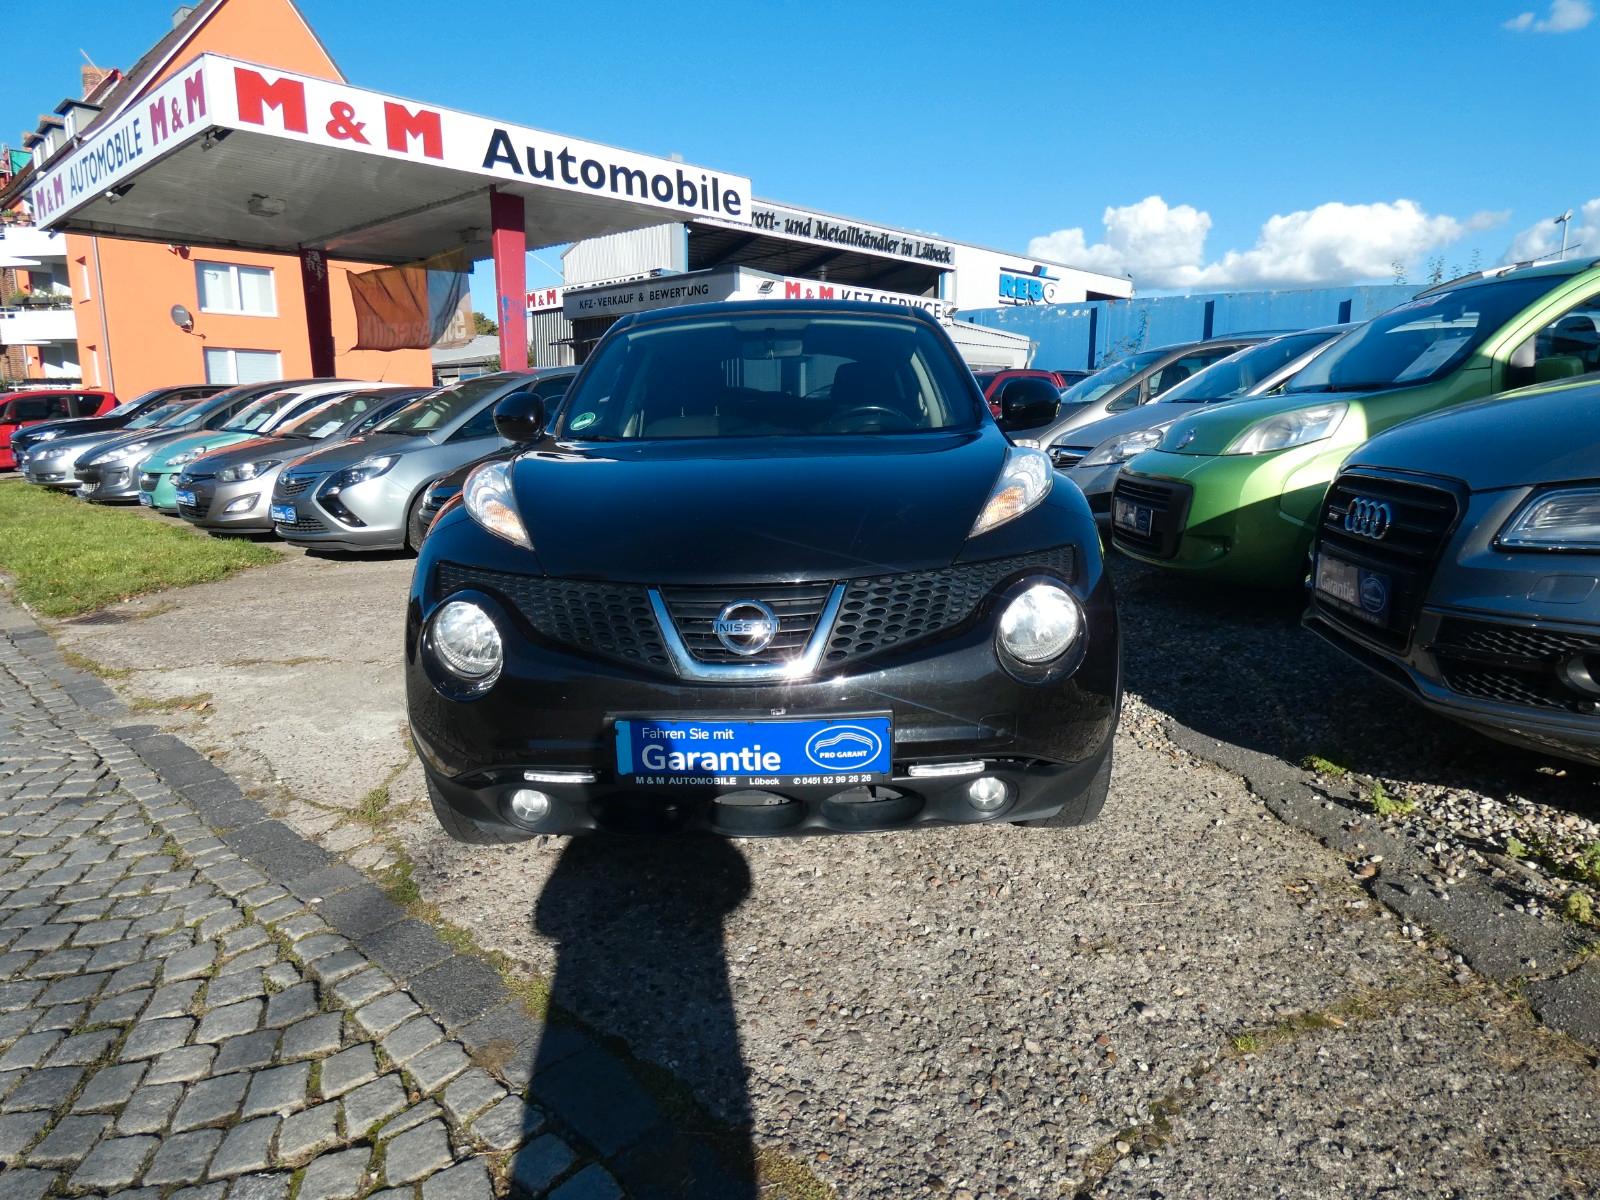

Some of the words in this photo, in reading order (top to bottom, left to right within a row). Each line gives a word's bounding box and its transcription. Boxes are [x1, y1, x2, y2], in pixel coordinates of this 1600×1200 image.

[36, 187, 47, 220] M
[47, 189, 54, 214] &
[53, 173, 65, 209] M
[69, 118, 144, 198] AUTOMOBILE
[149, 96, 169, 147] M
[171, 98, 185, 133] &
[184, 69, 207, 123] M
[234, 67, 309, 134] M
[325, 100, 372, 145] &
[383, 101, 444, 161] M
[482, 128, 741, 216] Automobile
[784, 217, 812, 237] und
[814, 220, 899, 253] Metallhändler
[901, 237, 913, 256] in
[915, 242, 951, 264] Lübeck
[527, 293, 536, 308] M
[546, 289, 557, 305] M
[638, 292, 644, 302] &
[649, 284, 709, 301] BEWERTUNG
[785, 281, 801, 300] M
[819, 286, 834, 300] M
[719, 622, 772, 632] NISSN
[642, 727, 686, 739] Fahren
[690, 728, 709, 740] Sie
[713, 729, 735, 740] mit
[641, 744, 782, 771] Garantie
[837, 750, 868, 758] GARANT
[636, 776, 644, 785] M
[647, 776, 654, 785] &
[656, 776, 665, 785] M
[669, 777, 737, 785] AUTOMOBILE
[749, 777, 780, 785] Lübeck
[802, 776, 821, 785] 0451
[823, 776, 834, 784] 92
